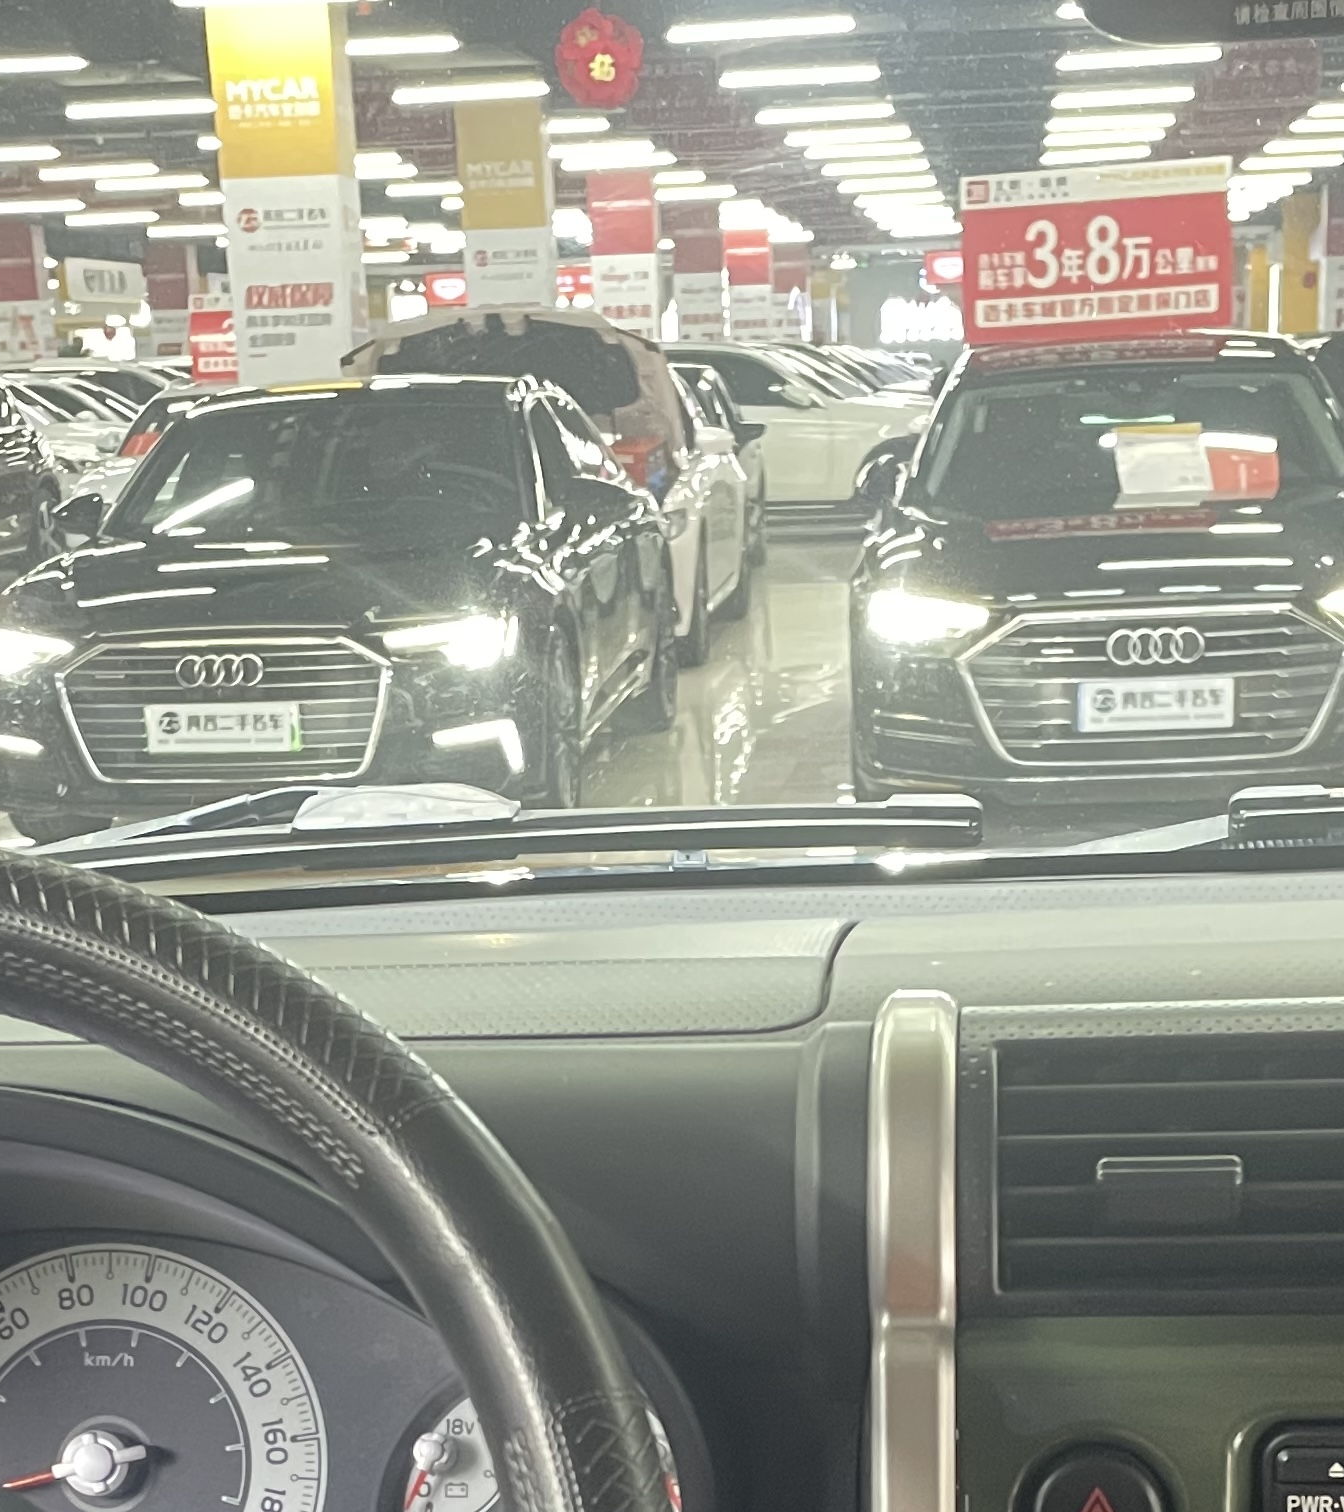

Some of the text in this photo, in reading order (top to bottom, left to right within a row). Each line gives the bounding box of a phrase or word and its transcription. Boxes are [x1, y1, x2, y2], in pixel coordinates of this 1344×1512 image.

[226, 77, 320, 102] MYCAR
[58, 1284, 94, 1310] 80
[121, 1283, 167, 1312] 100
[184, 1304, 228, 1344] 120
[83, 1353, 135, 1368] km/h
[232, 1352, 272, 1398] 140
[261, 1417, 288, 1465] 160
